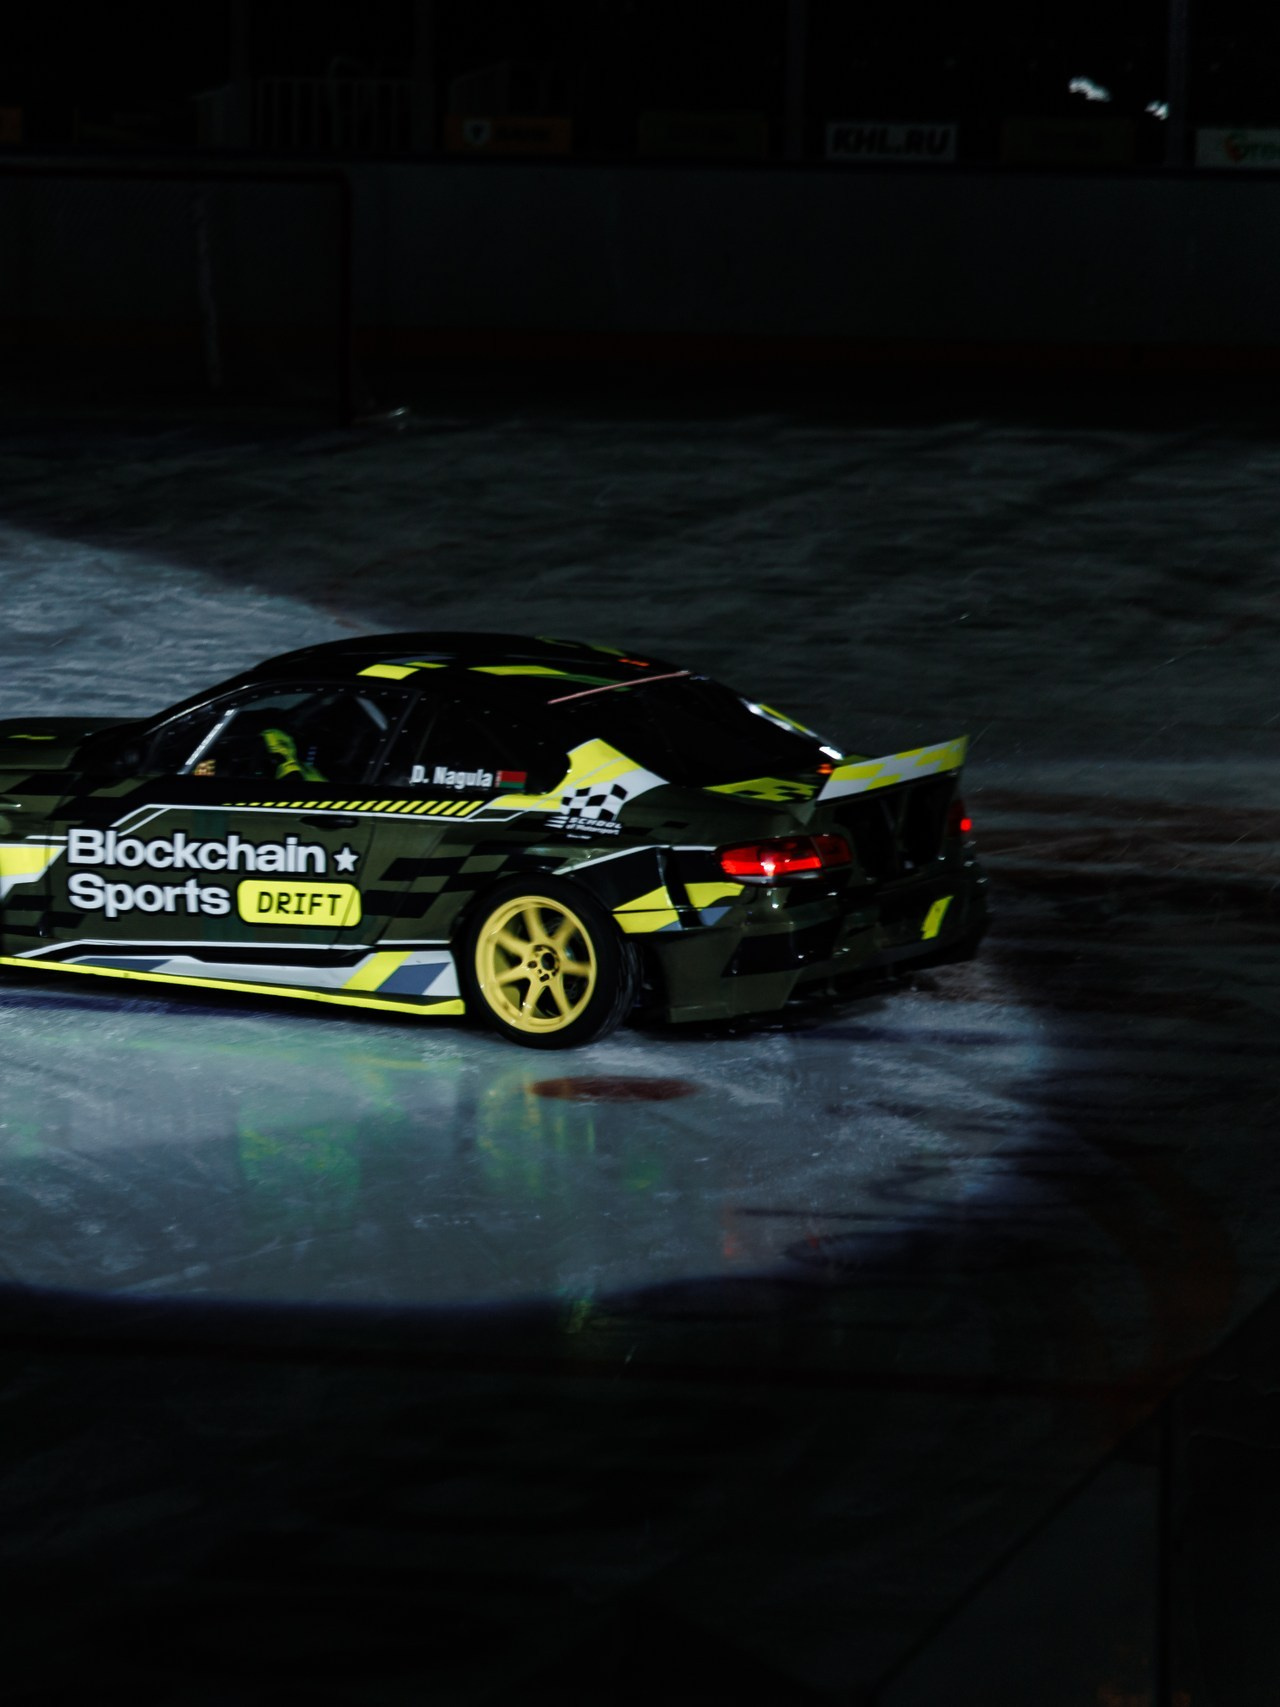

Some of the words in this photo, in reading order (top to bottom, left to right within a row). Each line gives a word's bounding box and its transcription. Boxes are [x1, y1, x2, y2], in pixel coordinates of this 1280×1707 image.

[831, 128, 949, 155] KHL.RU
[410, 764, 430, 784] D.
[432, 766, 494, 790] Nagula
[67, 828, 326, 874] Blockchain
[68, 873, 232, 918] Sports
[257, 891, 343, 917] DRIFT
